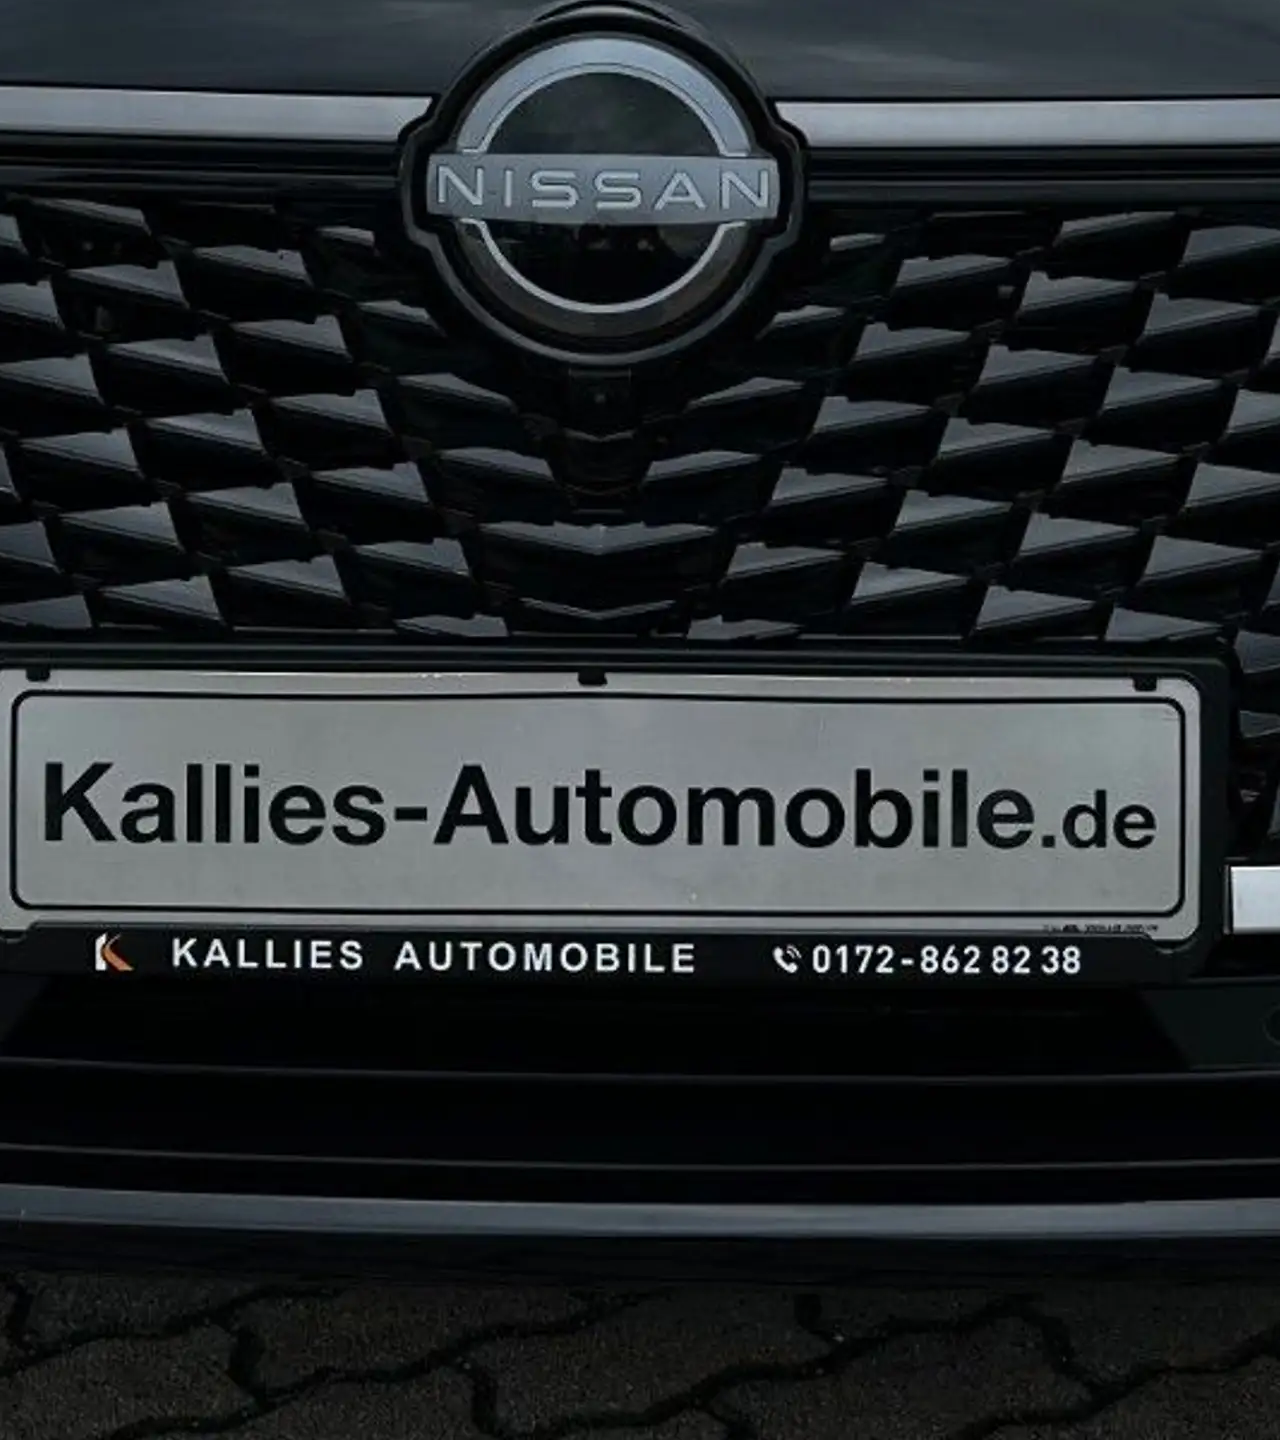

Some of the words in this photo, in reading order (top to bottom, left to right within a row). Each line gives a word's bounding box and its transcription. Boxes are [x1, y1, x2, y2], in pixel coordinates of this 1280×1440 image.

[436, 164, 770, 211] NISSAN
[44, 762, 1157, 850] Kallies-Automobile.de
[172, 937, 363, 972] KALLIES
[394, 940, 695, 973] AUTOMOBILE
